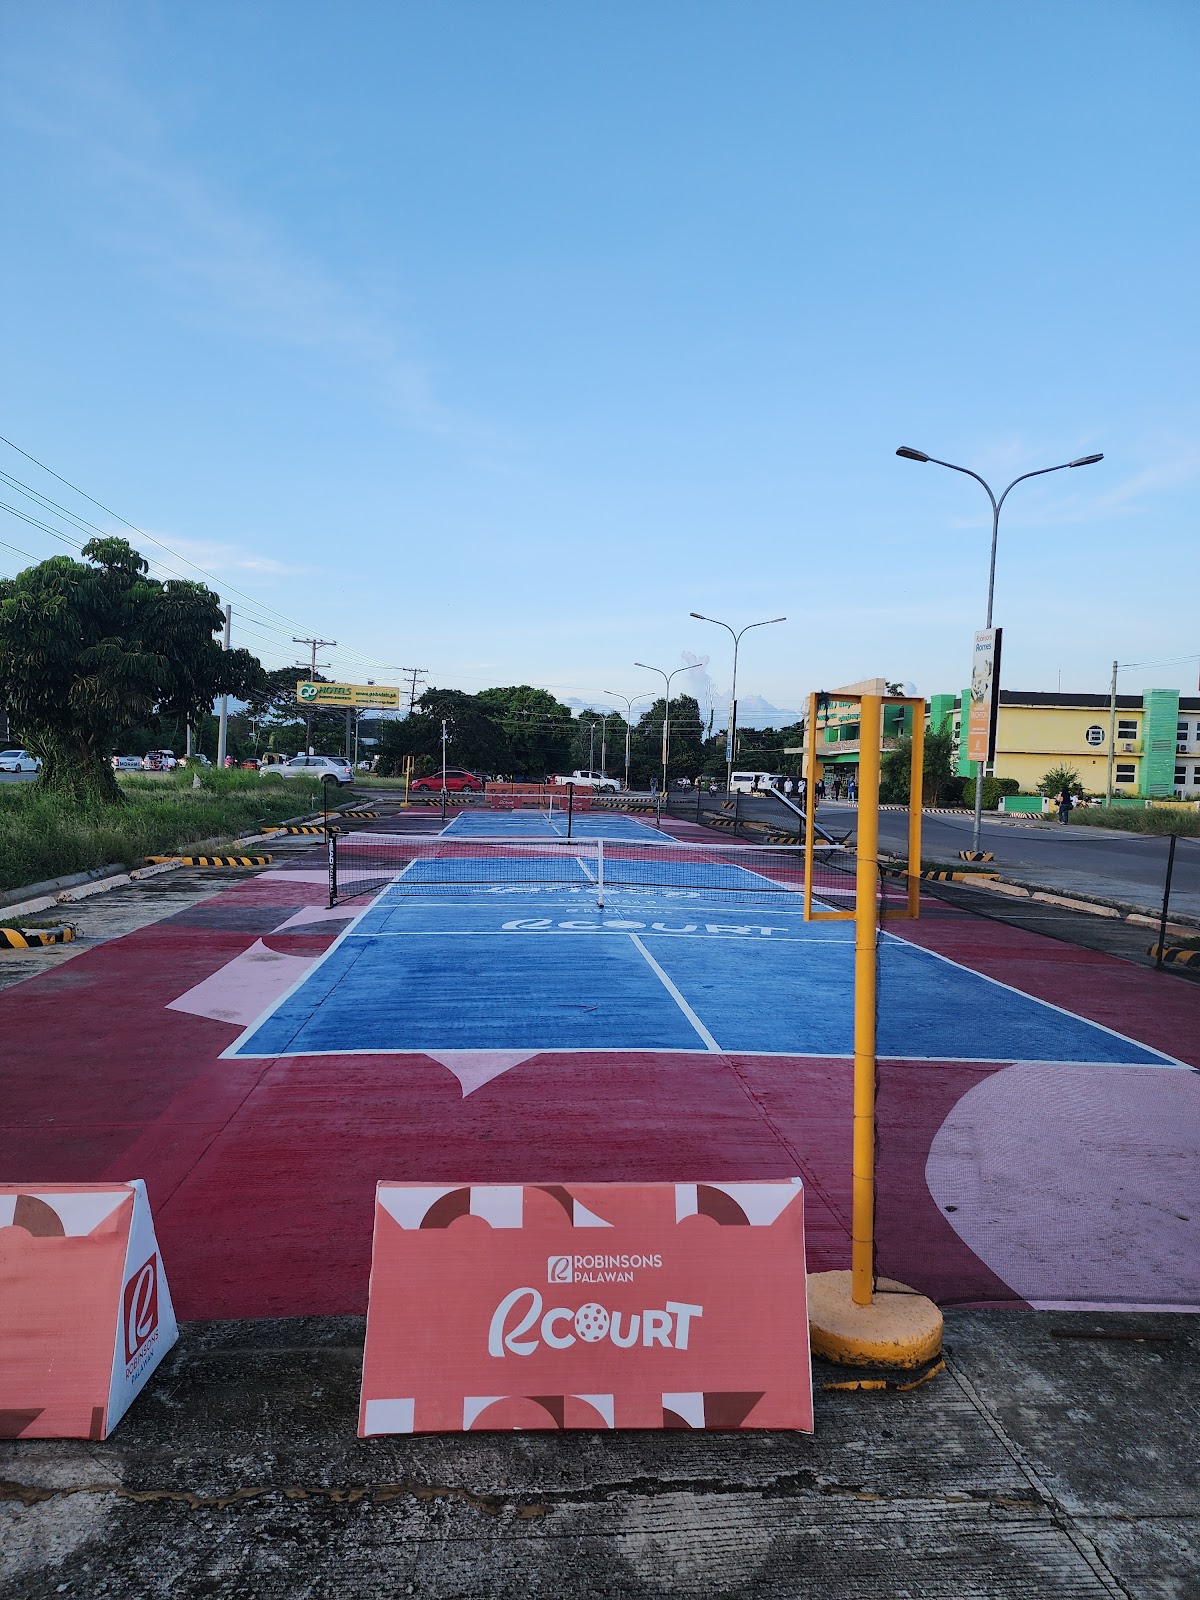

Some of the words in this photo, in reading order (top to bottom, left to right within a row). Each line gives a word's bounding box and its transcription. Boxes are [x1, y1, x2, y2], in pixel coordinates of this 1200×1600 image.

[319, 686, 352, 695] HOTELS
[574, 1254, 663, 1269] ROBINSONS
[574, 1271, 634, 1283] PALAWAN
[125, 1331, 159, 1381] ROBINSONS
[131, 1348, 155, 1384] PALAWAN
